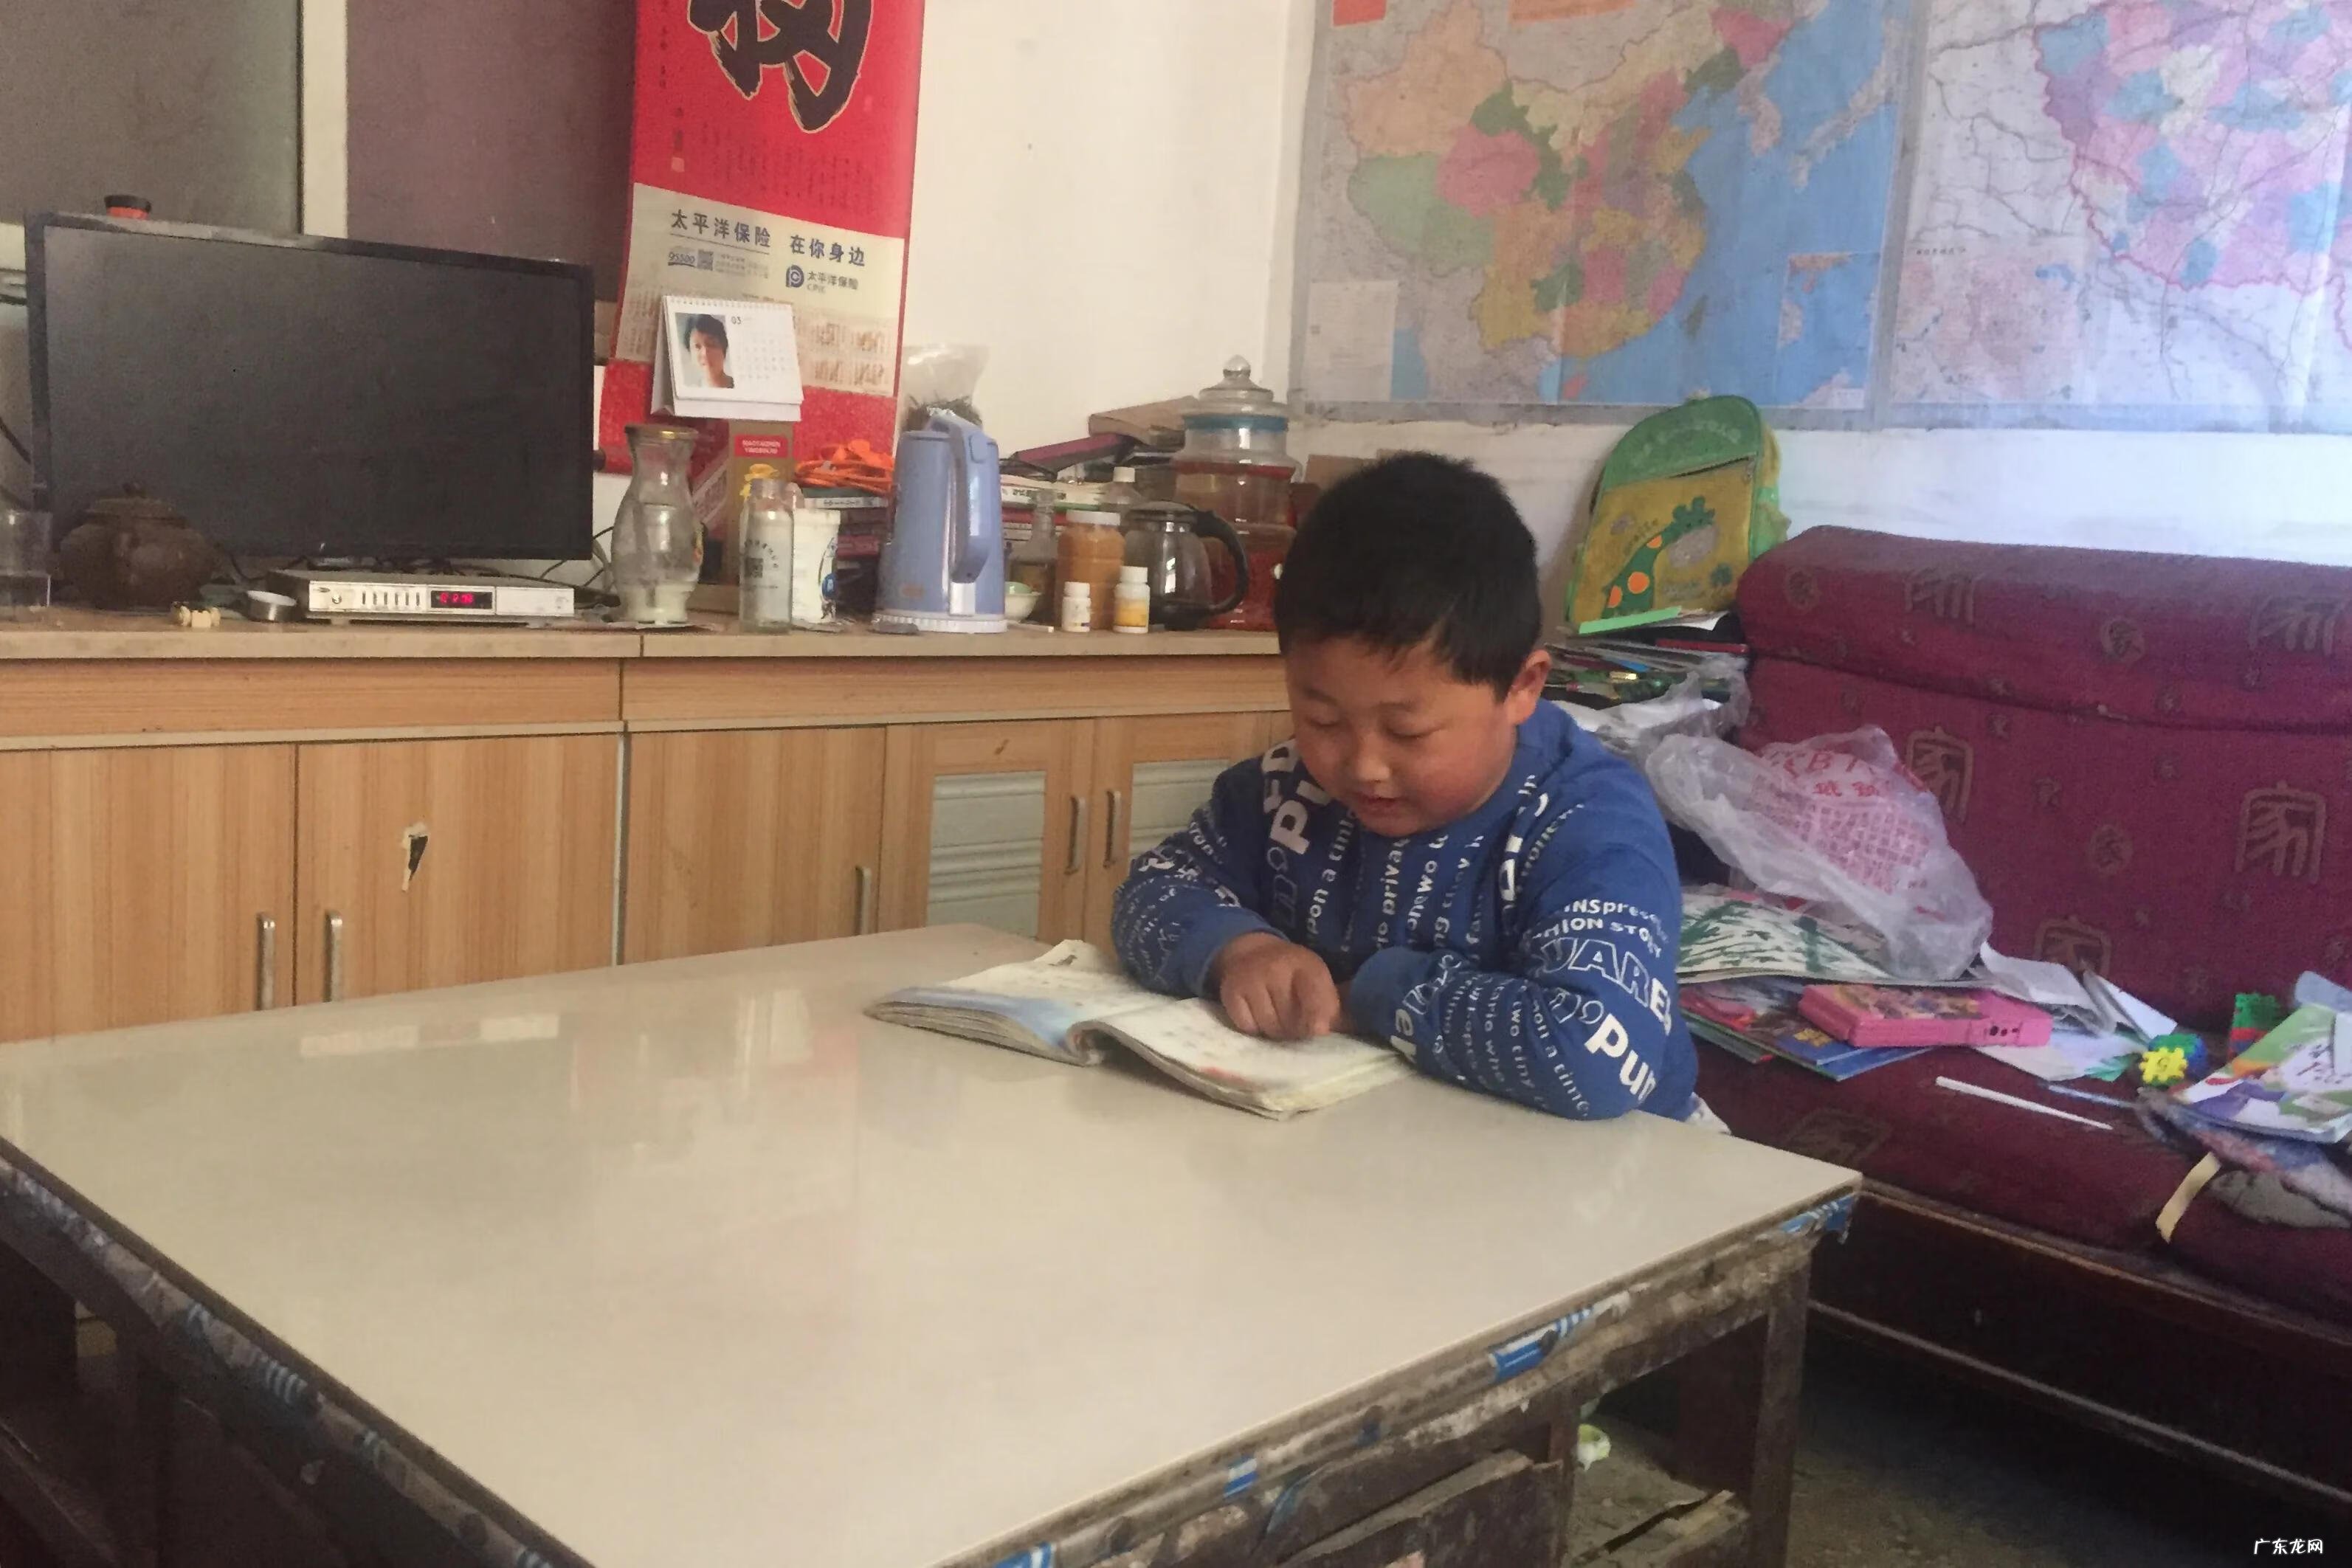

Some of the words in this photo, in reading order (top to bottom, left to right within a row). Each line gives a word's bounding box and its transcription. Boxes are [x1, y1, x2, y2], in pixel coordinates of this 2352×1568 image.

[671, 208, 770, 249] 太平洋保险
[790, 234, 865, 267] 在你身边
